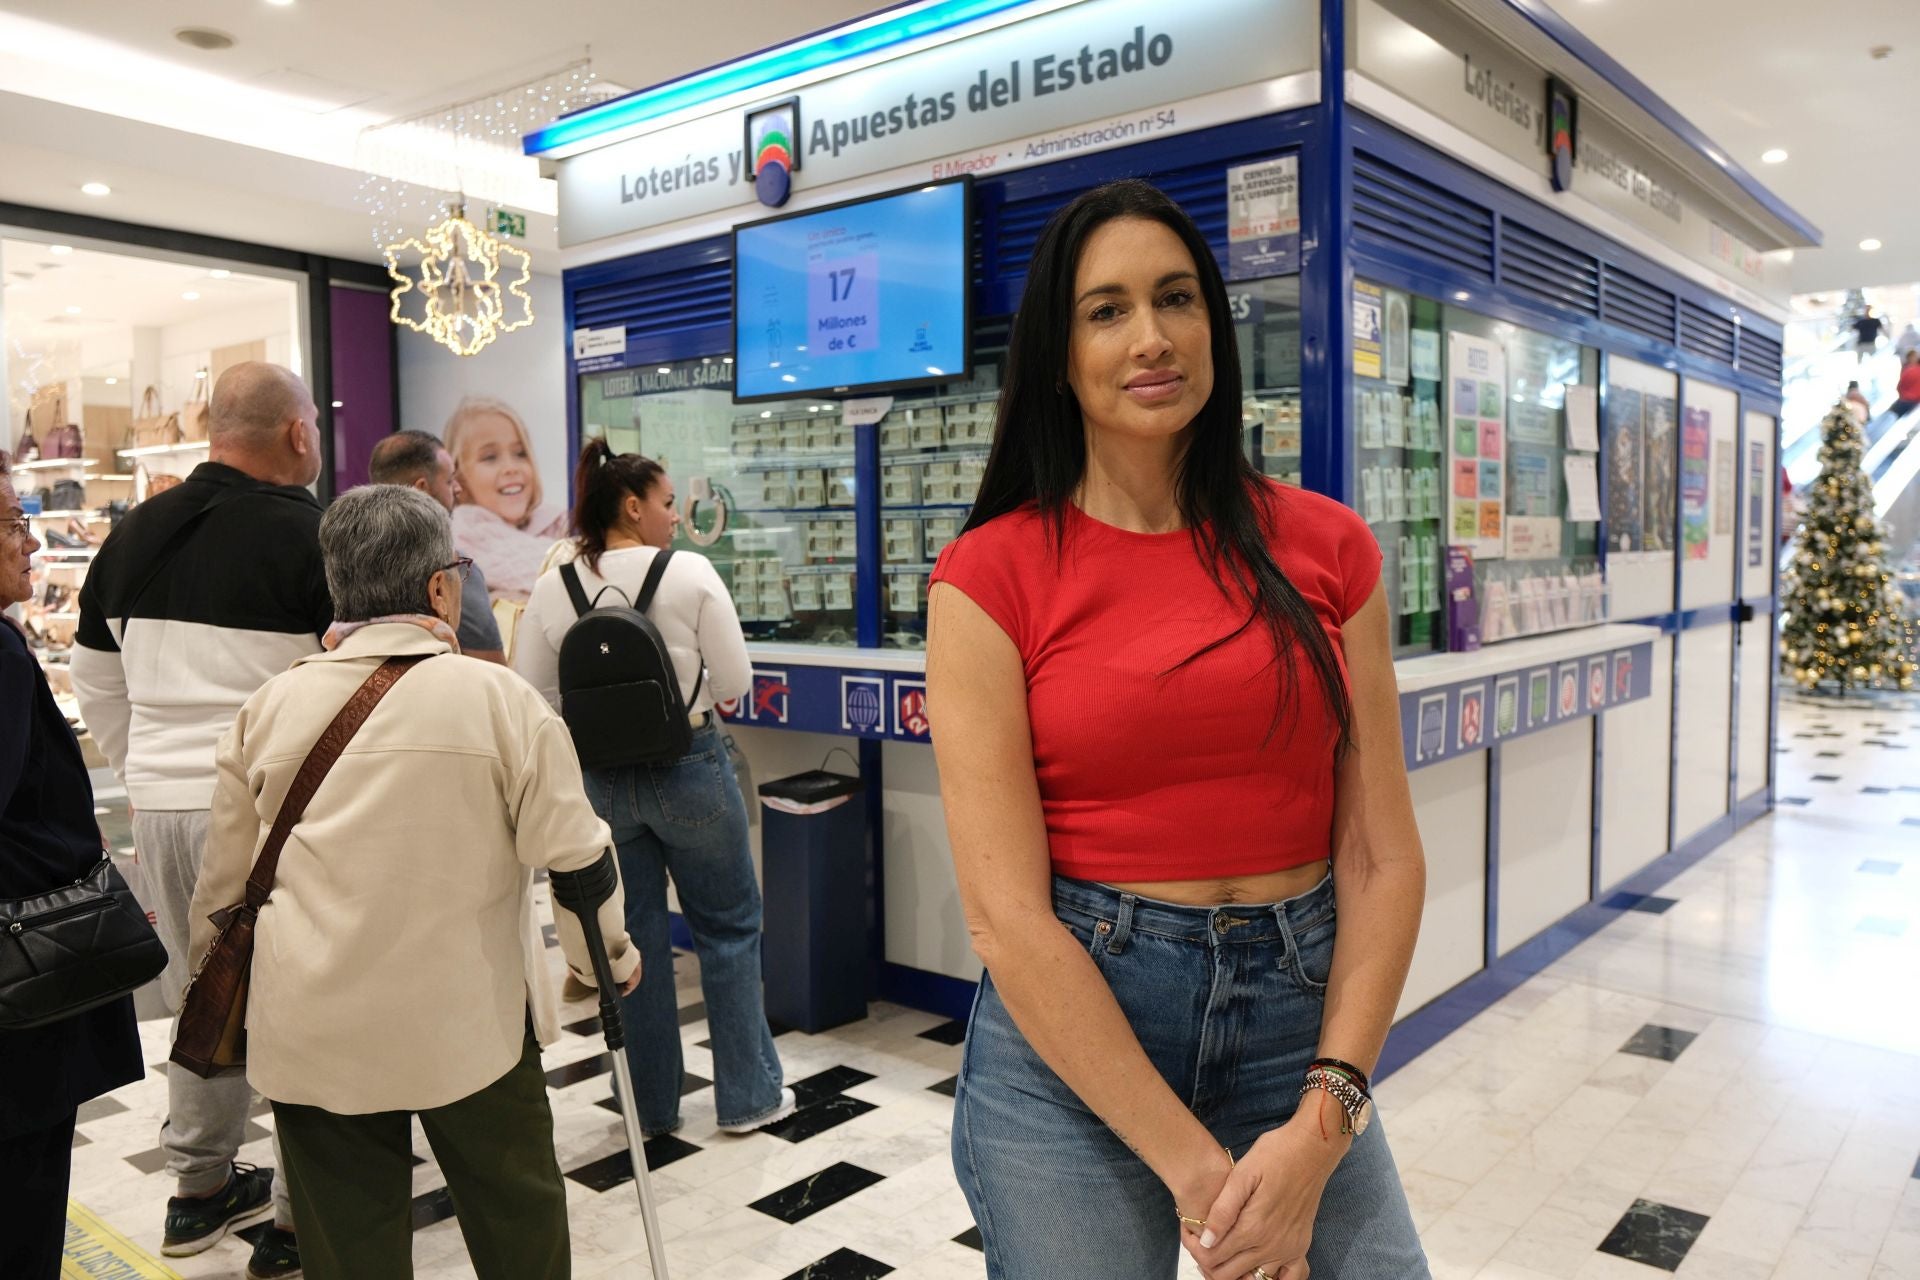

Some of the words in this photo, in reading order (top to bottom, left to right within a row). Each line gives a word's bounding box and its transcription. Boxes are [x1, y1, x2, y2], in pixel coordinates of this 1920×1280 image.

[1464, 54, 1531, 130] Loterías
[621, 154, 719, 204] Loterías
[728, 150, 742, 186] y
[809, 90, 956, 157] Apuestas
[967, 60, 1020, 113] del
[1033, 25, 1173, 97] Estado
[931, 165, 945, 180] El
[945, 154, 998, 177] Mirador
[1024, 121, 1134, 159] Administración
[1156, 109, 1176, 130] 54
[1243, 166, 1282, 180] CENTRO
[828, 268, 856, 302] 17
[1230, 293, 1250, 320] ES
[818, 315, 867, 332] Millones
[828, 337, 844, 351] de
[847, 335, 857, 348] €
[641, 368, 689, 391] NACIONAL
